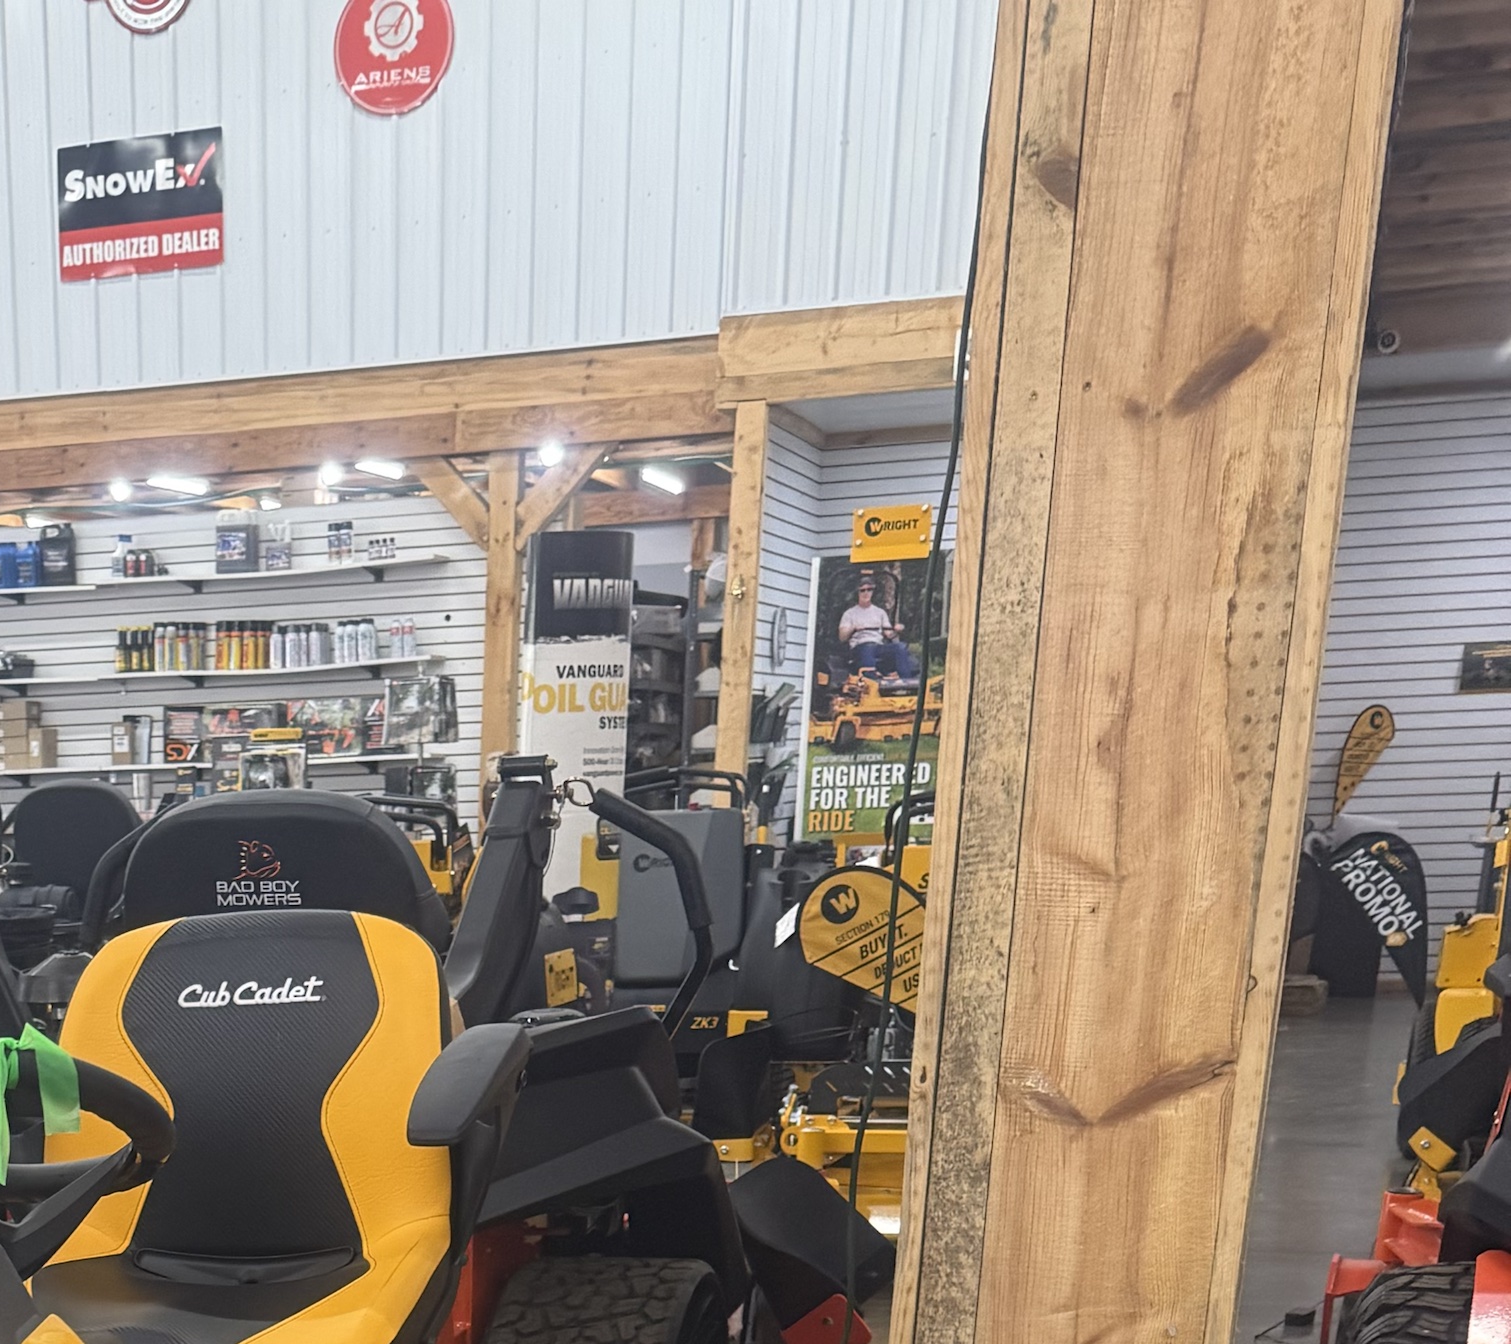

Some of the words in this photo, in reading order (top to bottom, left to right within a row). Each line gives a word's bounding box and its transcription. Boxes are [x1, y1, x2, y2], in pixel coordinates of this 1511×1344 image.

[354, 65, 431, 86] ARIENS
[62, 235, 159, 268] AUTHORIZED
[161, 228, 220, 257] DEALER
[864, 517, 920, 537] WRIGHT
[532, 682, 586, 715] OIL
[809, 788, 849, 811] FOR
[854, 786, 892, 809] THE
[808, 810, 855, 833] RIDE
[216, 881, 254, 893] BAD
[259, 880, 300, 893] BOY
[1330, 858, 1401, 937] PROMO
[1349, 848, 1424, 940] NATIONAL
[216, 893, 302, 907] MOWERS
[835, 921, 874, 945] SECTION
[859, 933, 888, 961] BUY
[874, 949, 917, 980] DEUCT
[177, 981, 231, 1008] Cub
[233, 975, 324, 1006] Cadet
[690, 1016, 719, 1030] ZK3
